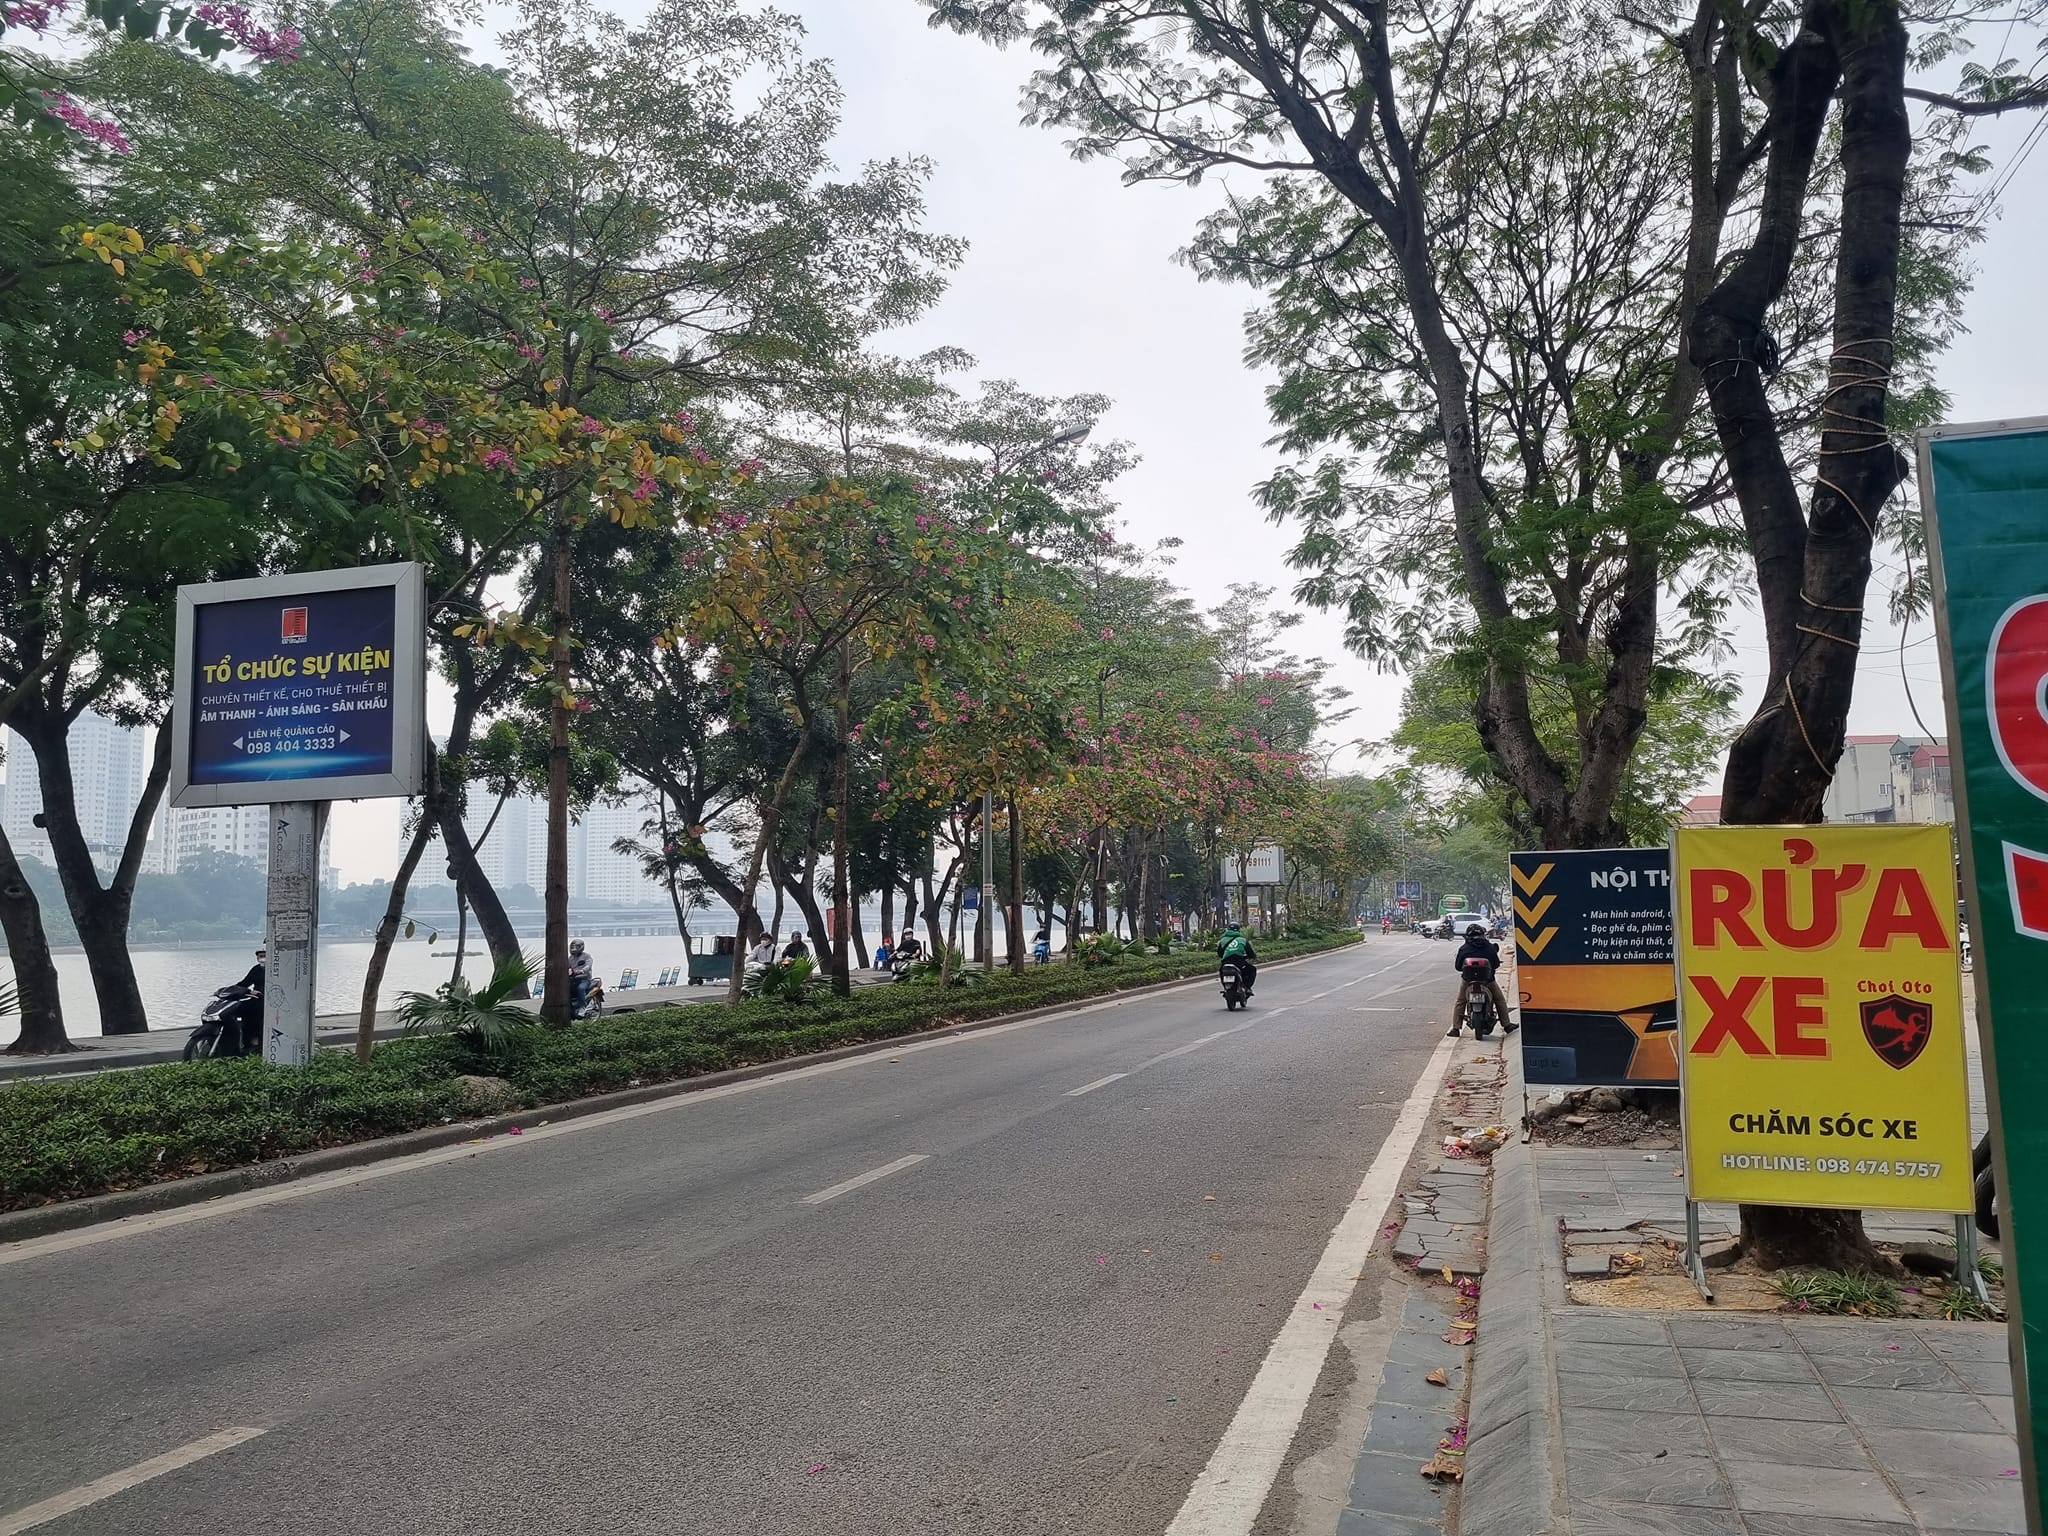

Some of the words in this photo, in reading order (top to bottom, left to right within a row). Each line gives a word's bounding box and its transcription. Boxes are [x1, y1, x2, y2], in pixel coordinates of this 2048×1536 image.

[203, 654, 231, 683] TỔ
[237, 654, 297, 680] CHỨC
[302, 652, 334, 679] SỰ
[338, 645, 390, 676] KIỆN
[201, 692, 240, 705] CHUYÊN
[243, 688, 271, 702] THIẾT
[273, 686, 289, 700] KẾ,
[291, 688, 313, 698] CHO
[316, 683, 342, 696] THUÊ
[345, 680, 374, 694] THIẾT
[377, 682, 387, 694] BỊ
[200, 710, 217, 722] ÂM
[220, 709, 256, 720] THANH
[266, 705, 289, 717] ÁNH
[291, 702, 321, 715] SÁNG
[332, 699, 354, 712] SÂN
[357, 696, 388, 710] KHẤU
[248, 728, 268, 739] LIÊN
[270, 727, 281, 739] HỆ
[284, 725, 315, 738] QUẢNG
[317, 723, 335, 734] CÁO
[247, 741, 271, 754] 098
[275, 740, 300, 752] 404
[304, 737, 335, 751] 3333
[1590, 866, 1637, 892] NỘI
[1643, 869, 1670, 887] TH
[1689, 837, 1953, 951] RỬA
[1590, 910, 1608, 919] Màn
[1610, 909, 1628, 918] hình
[1630, 909, 1665, 919] android,
[1591, 924, 1607, 934] Bọc
[1609, 922, 1626, 934] ghế
[1626, 923, 1639, 933] da,
[1641, 923, 1663, 933] phim
[1591, 937, 1608, 947] Phụ
[1610, 937, 1628, 947] kiện
[1630, 937, 1644, 947] nội
[1646, 936, 1665, 946] thất,
[1593, 950, 1609, 960] Rửa
[1611, 950, 1621, 960] và
[1623, 950, 1646, 960] chăm
[1648, 950, 1663, 959] sóc
[1857, 980, 1895, 993] Choi
[1902, 980, 1932, 994] Oto
[1688, 975, 1831, 1060] XE
[1729, 1108, 1810, 1135] CHĂM
[1819, 1112, 1874, 1138] SÓC
[1882, 1119, 1918, 1140] XE
[1722, 1154, 1811, 1172] HOTLINE:
[1816, 1158, 1850, 1174] 098
[1855, 1160, 1890, 1175] 474
[1895, 1162, 1941, 1178] 5757
